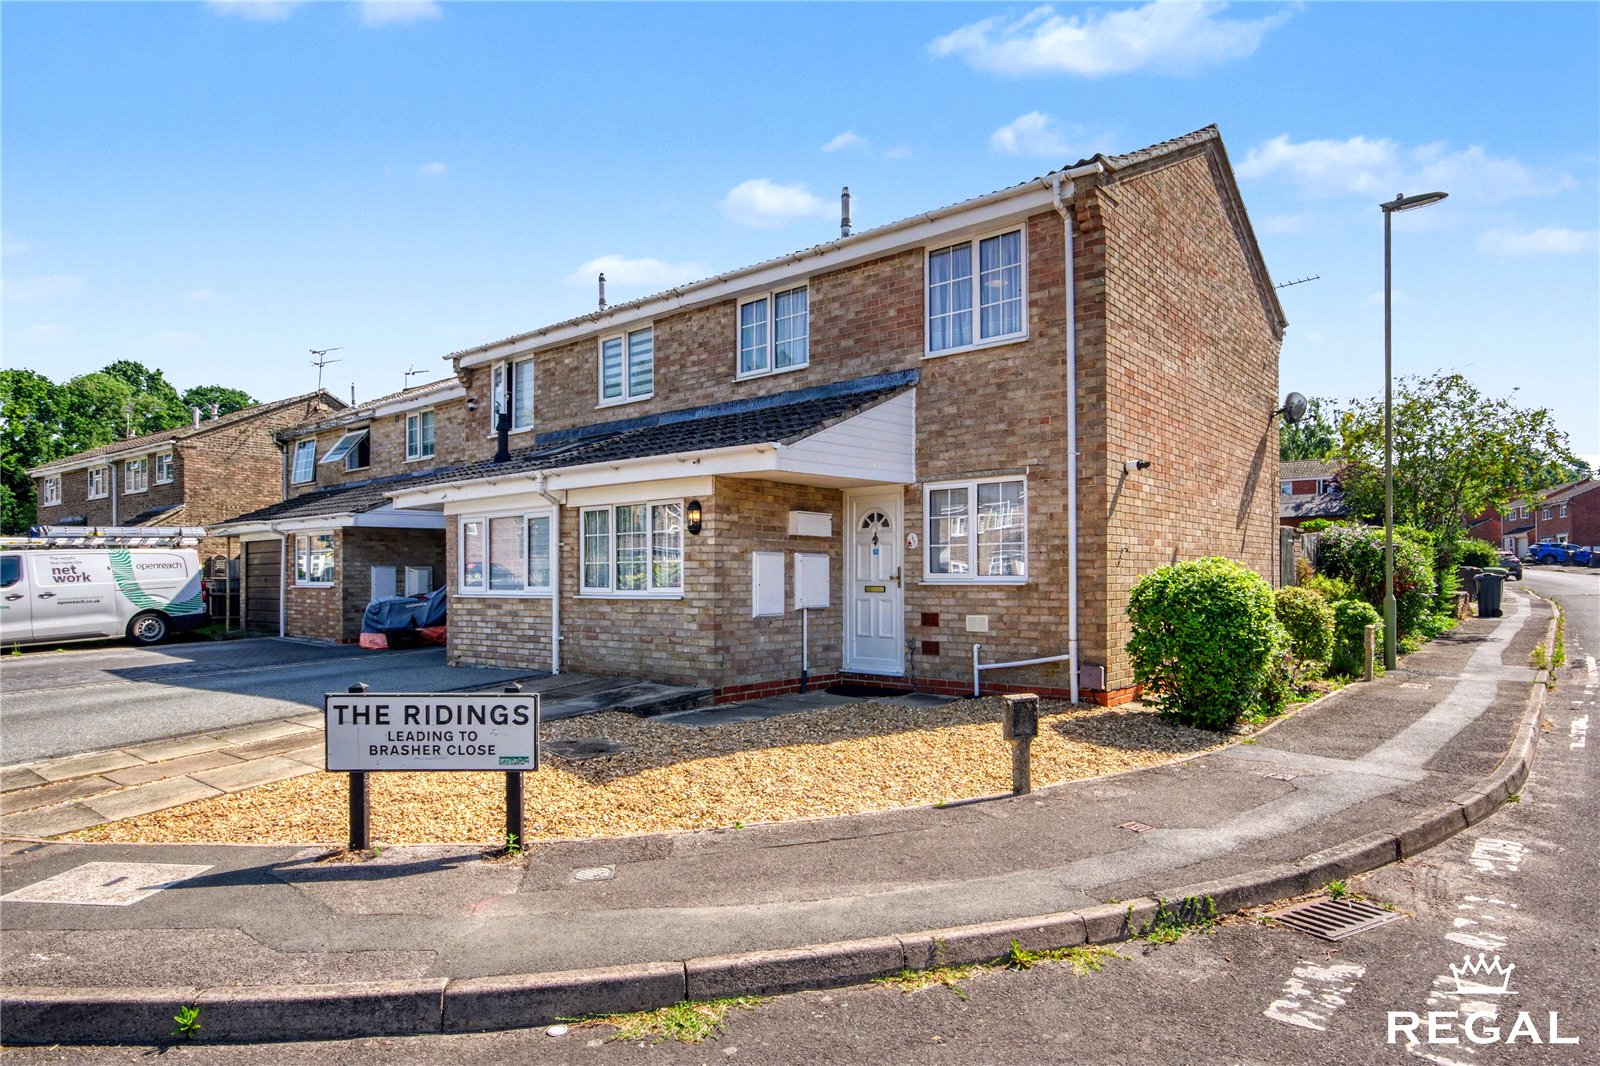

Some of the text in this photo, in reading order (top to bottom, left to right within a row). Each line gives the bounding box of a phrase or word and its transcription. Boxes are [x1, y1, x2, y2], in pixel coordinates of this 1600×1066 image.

[52, 564, 77, 575] net
[135, 562, 183, 571] openreach
[52, 571, 92, 584] work
[333, 704, 530, 726] THE RIDINGS
[387, 731, 478, 743] LEADING TO
[369, 745, 497, 757] BRASHER CLOSE
